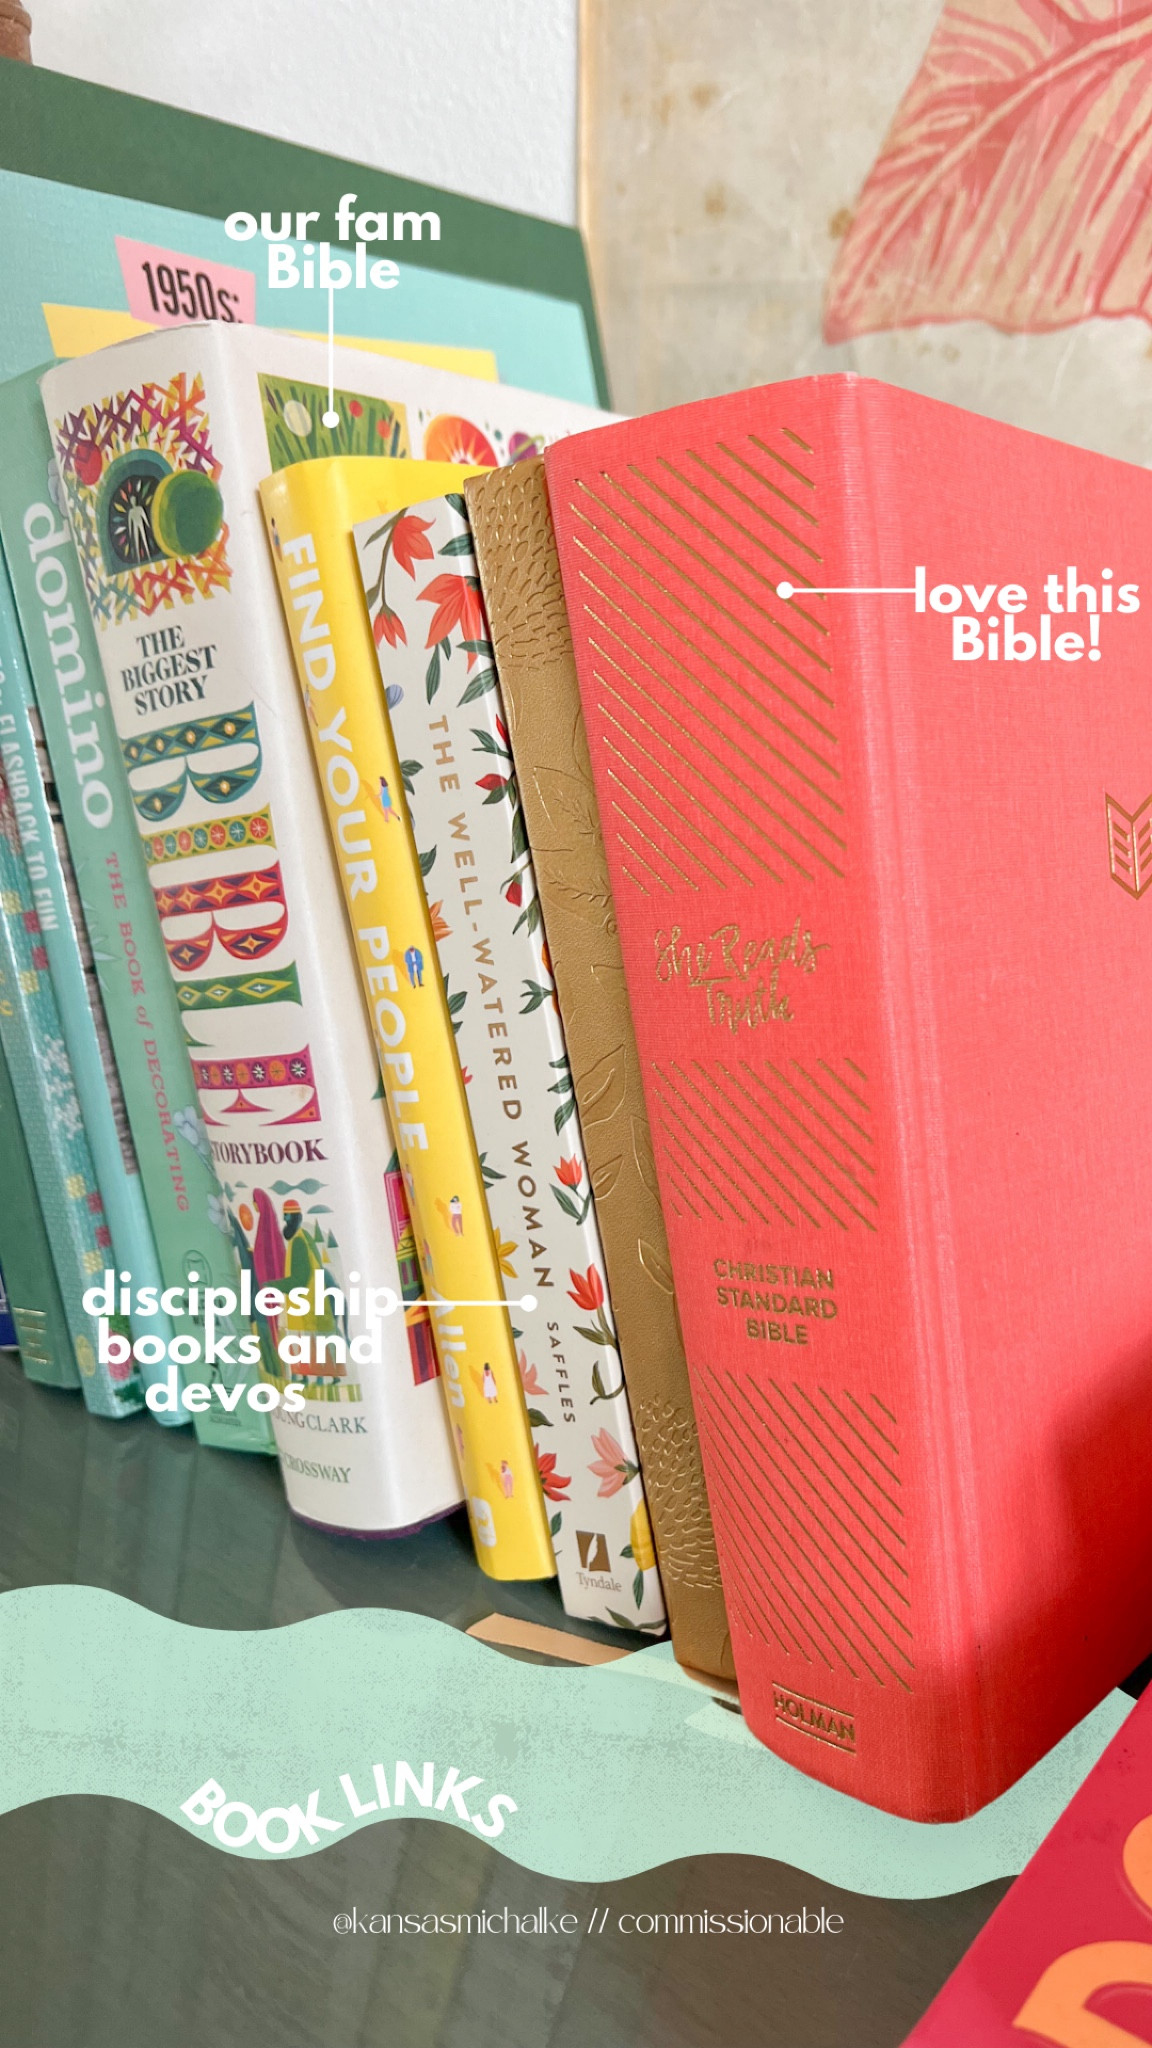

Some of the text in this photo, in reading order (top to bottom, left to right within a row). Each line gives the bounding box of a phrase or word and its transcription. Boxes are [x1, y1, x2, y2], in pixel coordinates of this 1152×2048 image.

[142, 261, 243, 323] 1950s:
[23, 502, 113, 829] domino
[120, 644, 217, 692] BIGGEST
[136, 625, 185, 658] THE
[134, 675, 208, 716] STORY
[25, 851, 48, 881] TO
[282, 533, 430, 1151] FIND YOUR PEOPLE
[33, 887, 60, 932] FUN
[121, 699, 323, 1129] BIBLE
[653, 914, 832, 984] She Reads
[428, 714, 554, 1287] THE WELL-WATERED WOMAN
[688, 965, 795, 1036] Truth
[105, 852, 190, 1212] THE BOOK of DECORATING
[210, 1138, 329, 1166] TORYBOOK
[713, 1257, 835, 1291] CHRISTIAN
[716, 1285, 838, 1320] STANDARD
[431, 1287, 466, 1408] Allen
[745, 1317, 808, 1345] BIBLE
[546, 1320, 576, 1424] SAFFLES
[575, 1571, 622, 1593] Tyndale
[772, 1690, 857, 1745] HOLMAN
